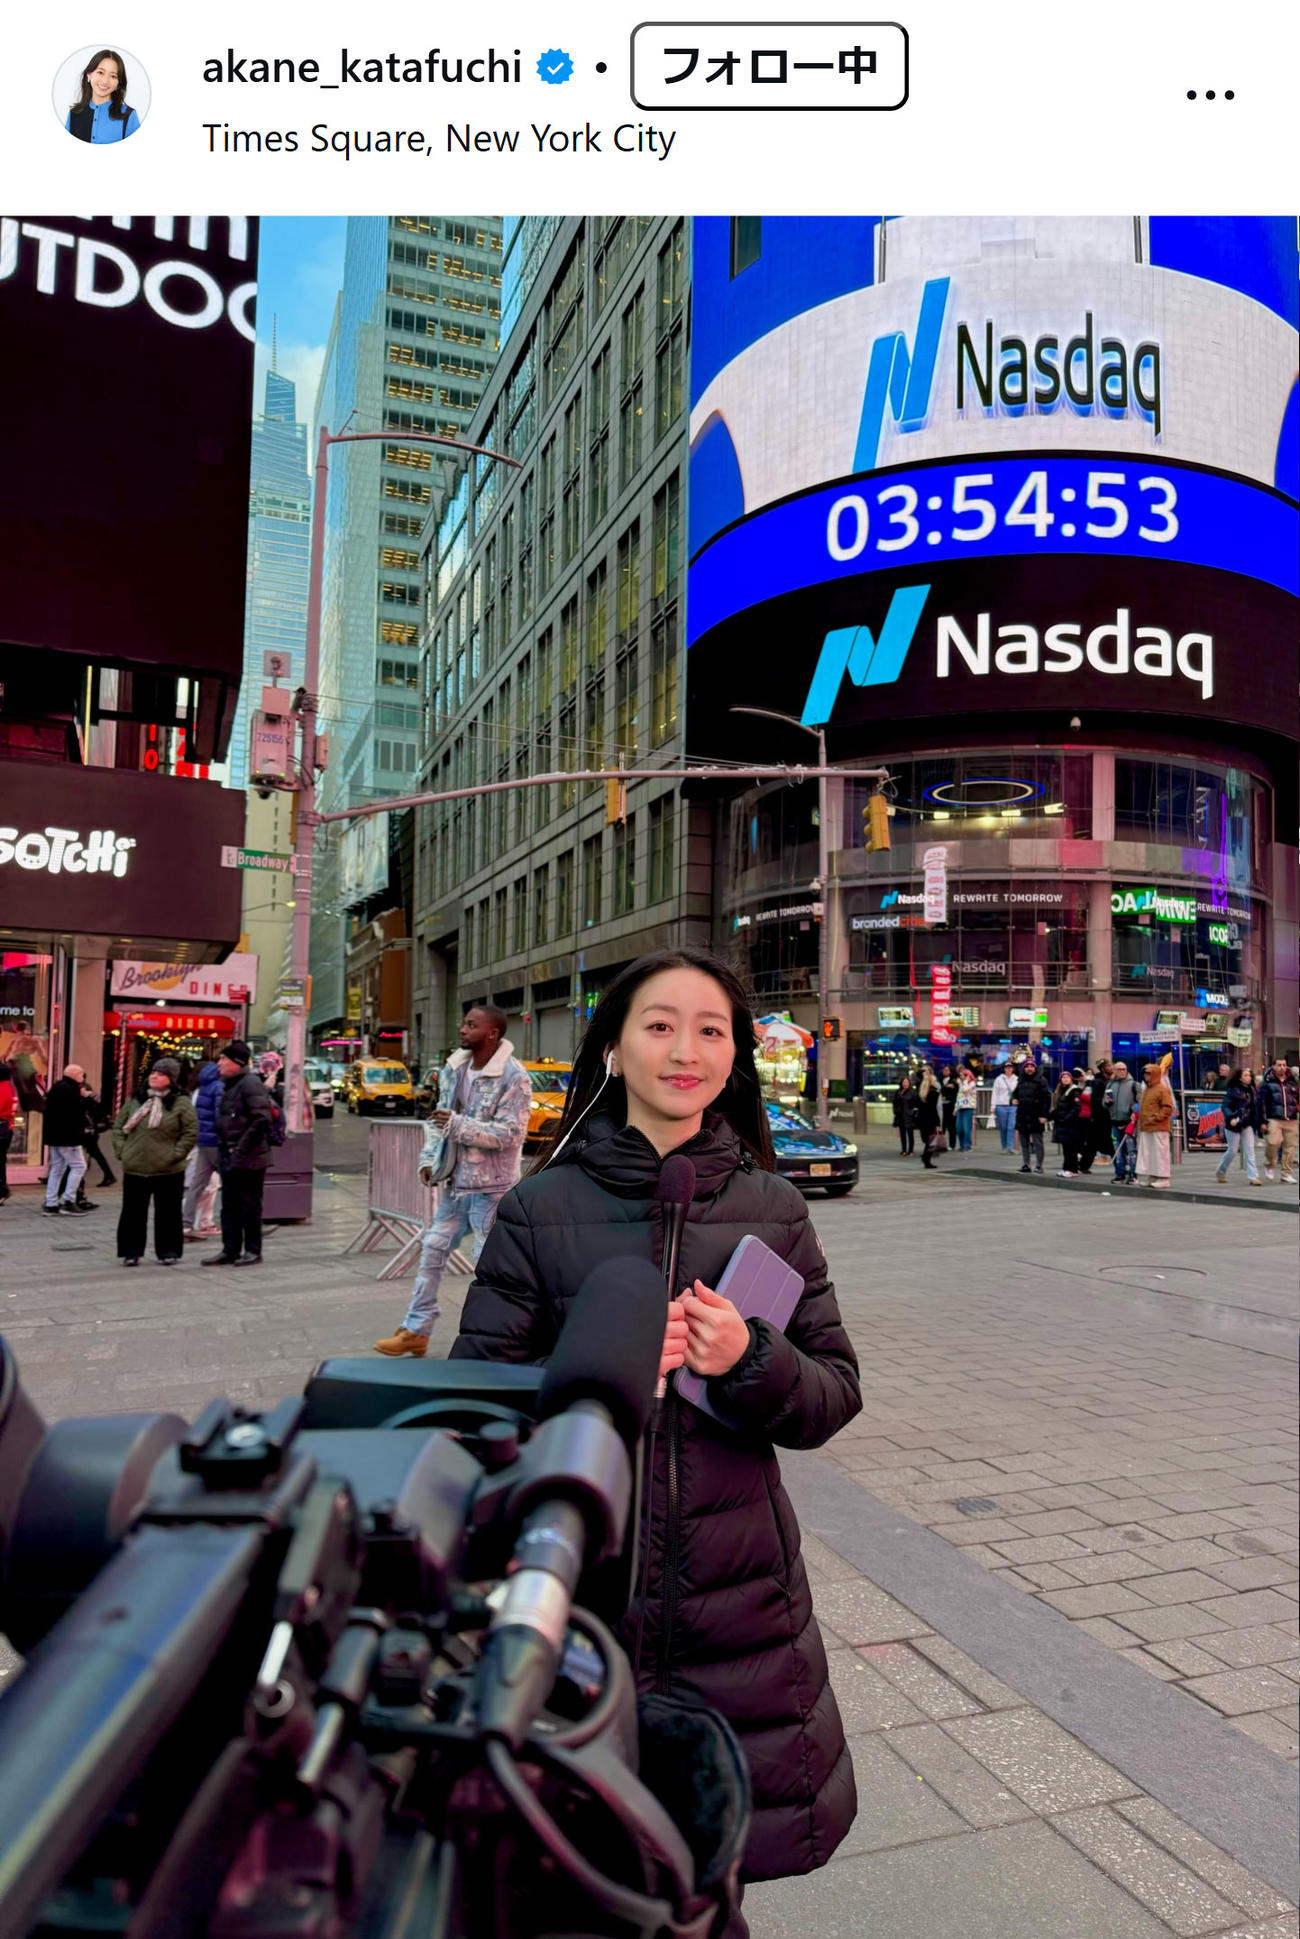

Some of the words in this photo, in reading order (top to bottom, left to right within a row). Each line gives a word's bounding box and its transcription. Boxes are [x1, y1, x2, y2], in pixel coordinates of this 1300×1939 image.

[956, 311, 1161, 437] Nasdaq
[827, 471, 1179, 560] 03:54:53
[936, 608, 1214, 699] Nasdaq
[238, 851, 288, 872] Broadway
[897, 893, 935, 904] Nasdaq
[953, 894, 998, 902] REWRITE
[1003, 894, 1063, 902] TOMORROW
[1197, 902, 1225, 914] REWRITE
[951, 960, 1006, 976] Nasdaq
[22, 1005, 35, 1016] to
